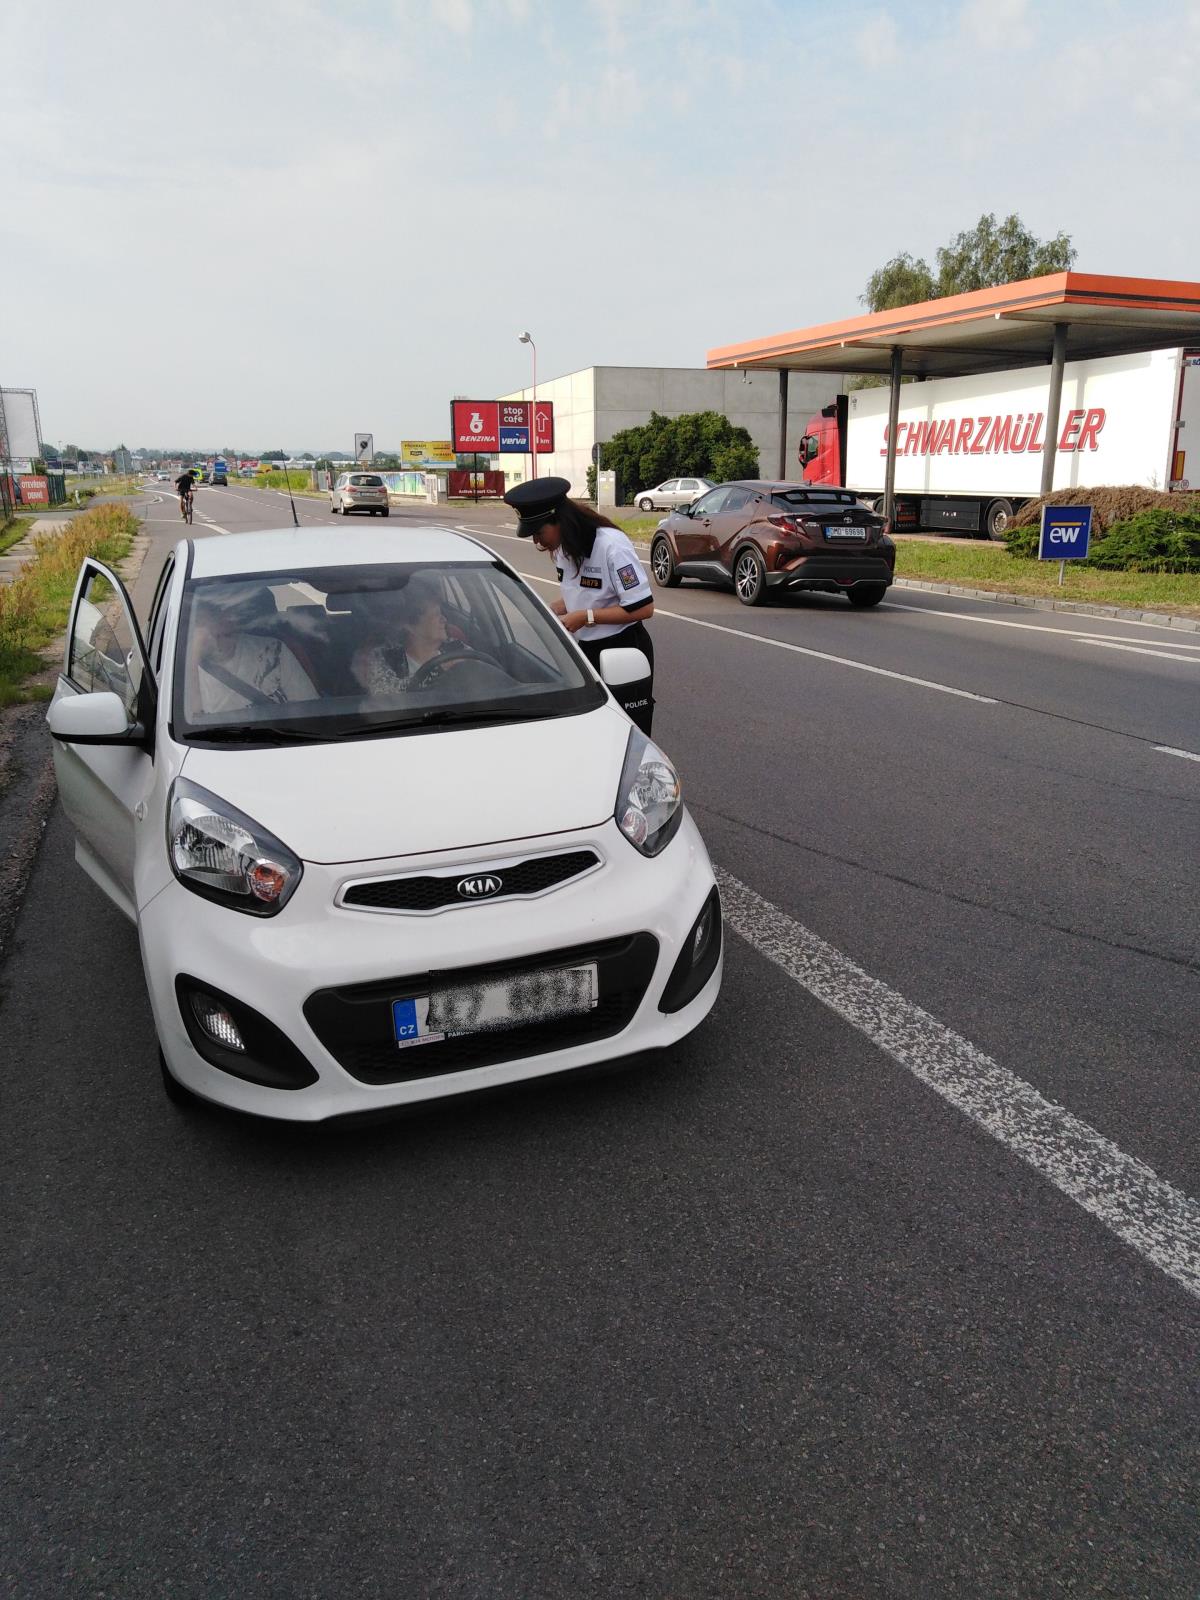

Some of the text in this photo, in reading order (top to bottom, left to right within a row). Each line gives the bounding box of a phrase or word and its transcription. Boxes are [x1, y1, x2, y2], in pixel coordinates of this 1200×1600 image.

[503, 406, 523, 415] stop
[503, 415, 523, 423] cafe
[880, 408, 1106, 456] CHWARZMÜLER
[501, 437, 527, 445] verva
[1050, 527, 1080, 543] ew
[464, 878, 497, 895] KIA
[400, 1024, 415, 1035] CZ
